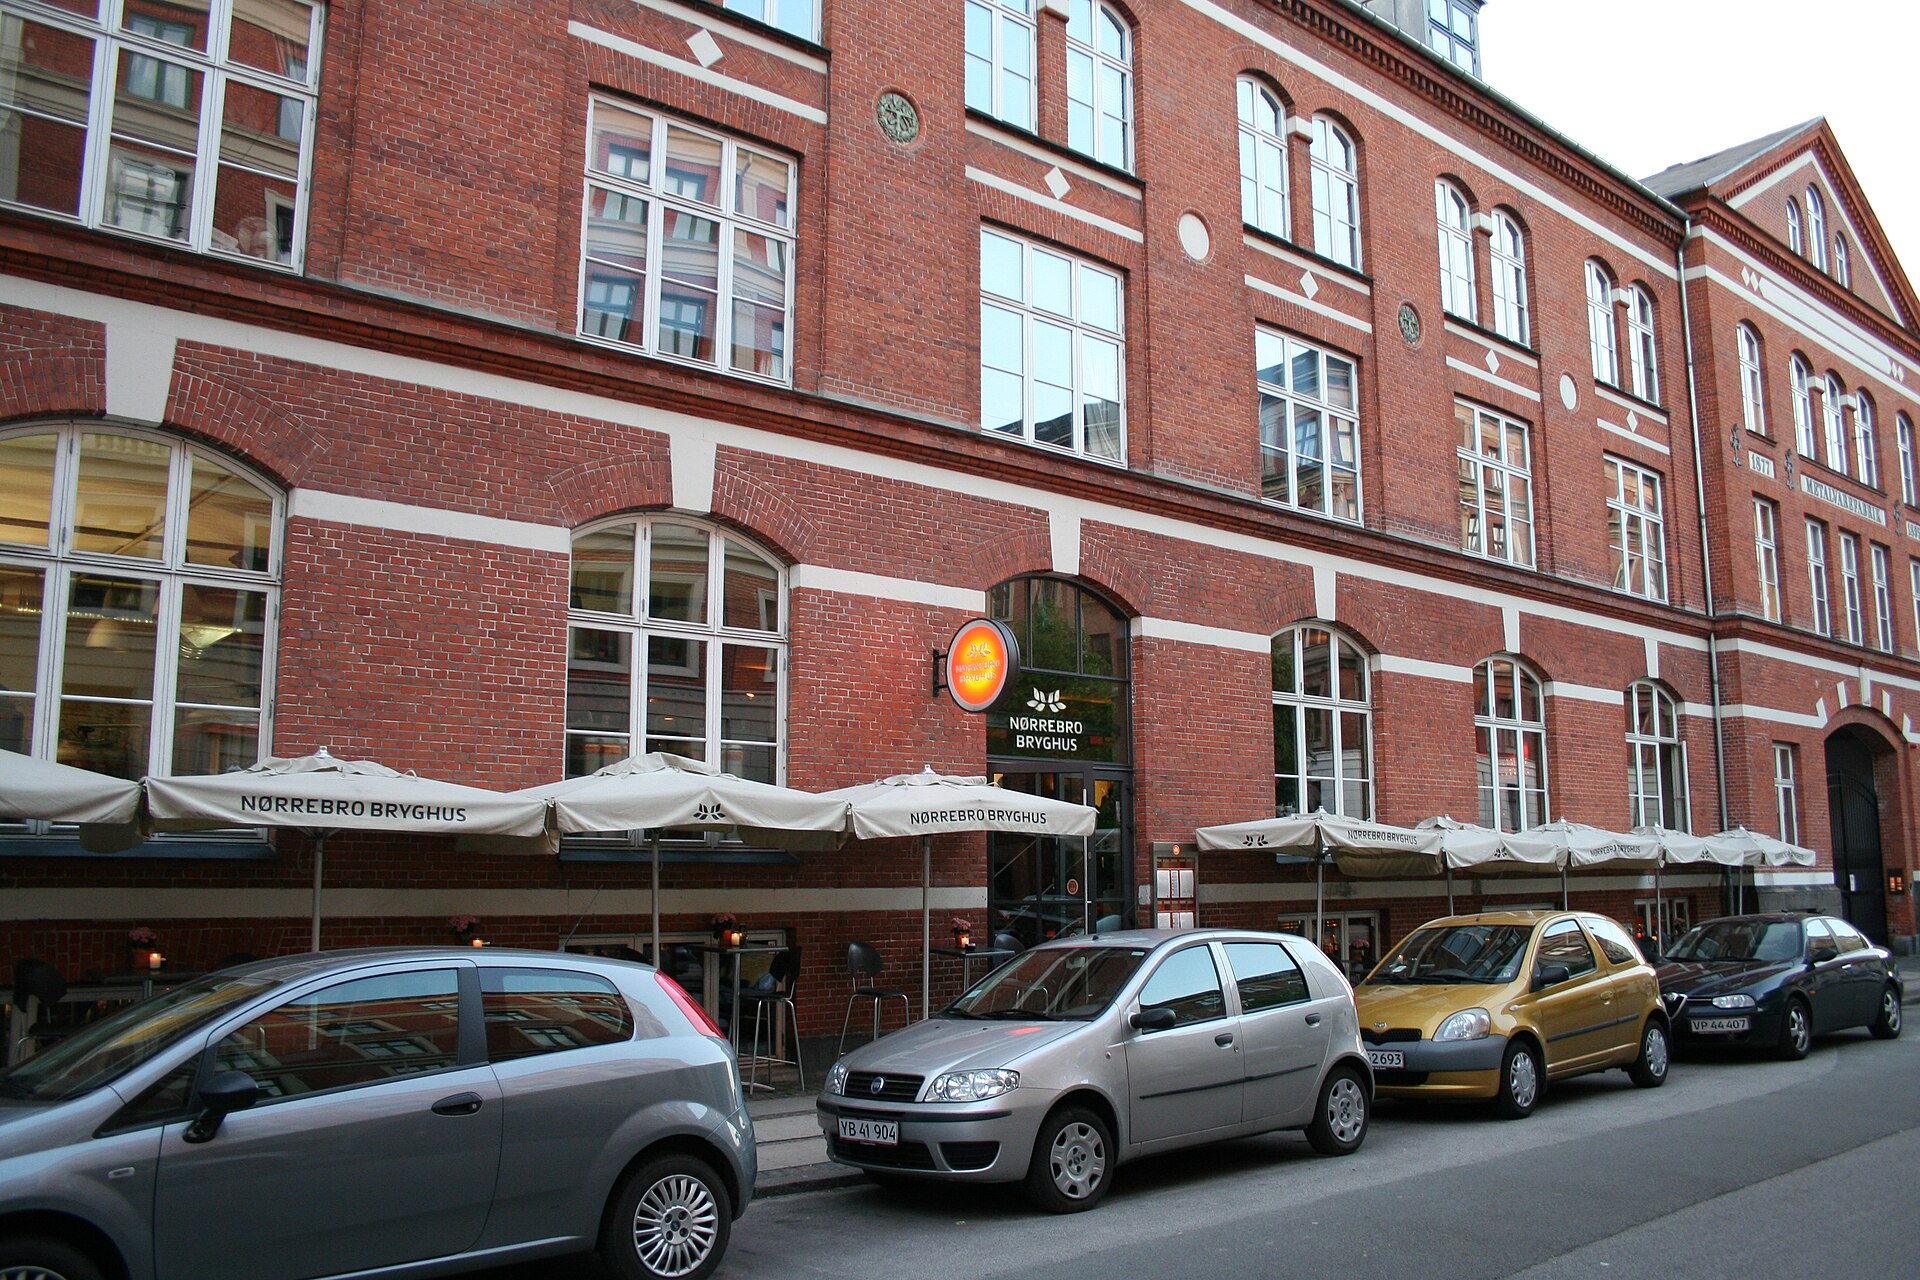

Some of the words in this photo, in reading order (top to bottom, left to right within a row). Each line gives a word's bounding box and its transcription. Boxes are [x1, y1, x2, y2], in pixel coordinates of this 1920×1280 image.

[1752, 453, 1770, 475] 1877
[1806, 478, 1882, 523] METALVAREFABRIK
[1009, 716, 1083, 735] NØRREBRO
[1016, 734, 1078, 752] BRYGHUS
[241, 795, 365, 816] NØRREBRO
[370, 801, 466, 822] BRYGHUS
[910, 809, 984, 825] NØRREBRO
[987, 810, 1046, 824] BRYGHUS
[1347, 829, 1385, 841] NØRREBRO
[1386, 832, 1417, 845] BRYGHUS
[1693, 1020, 1707, 1030] VP
[1710, 1021, 1724, 1029] 44
[1726, 1019, 1746, 1029] 407
[841, 1120, 856, 1136] YB
[859, 1122, 870, 1138] 41
[873, 1124, 896, 1141] 904
